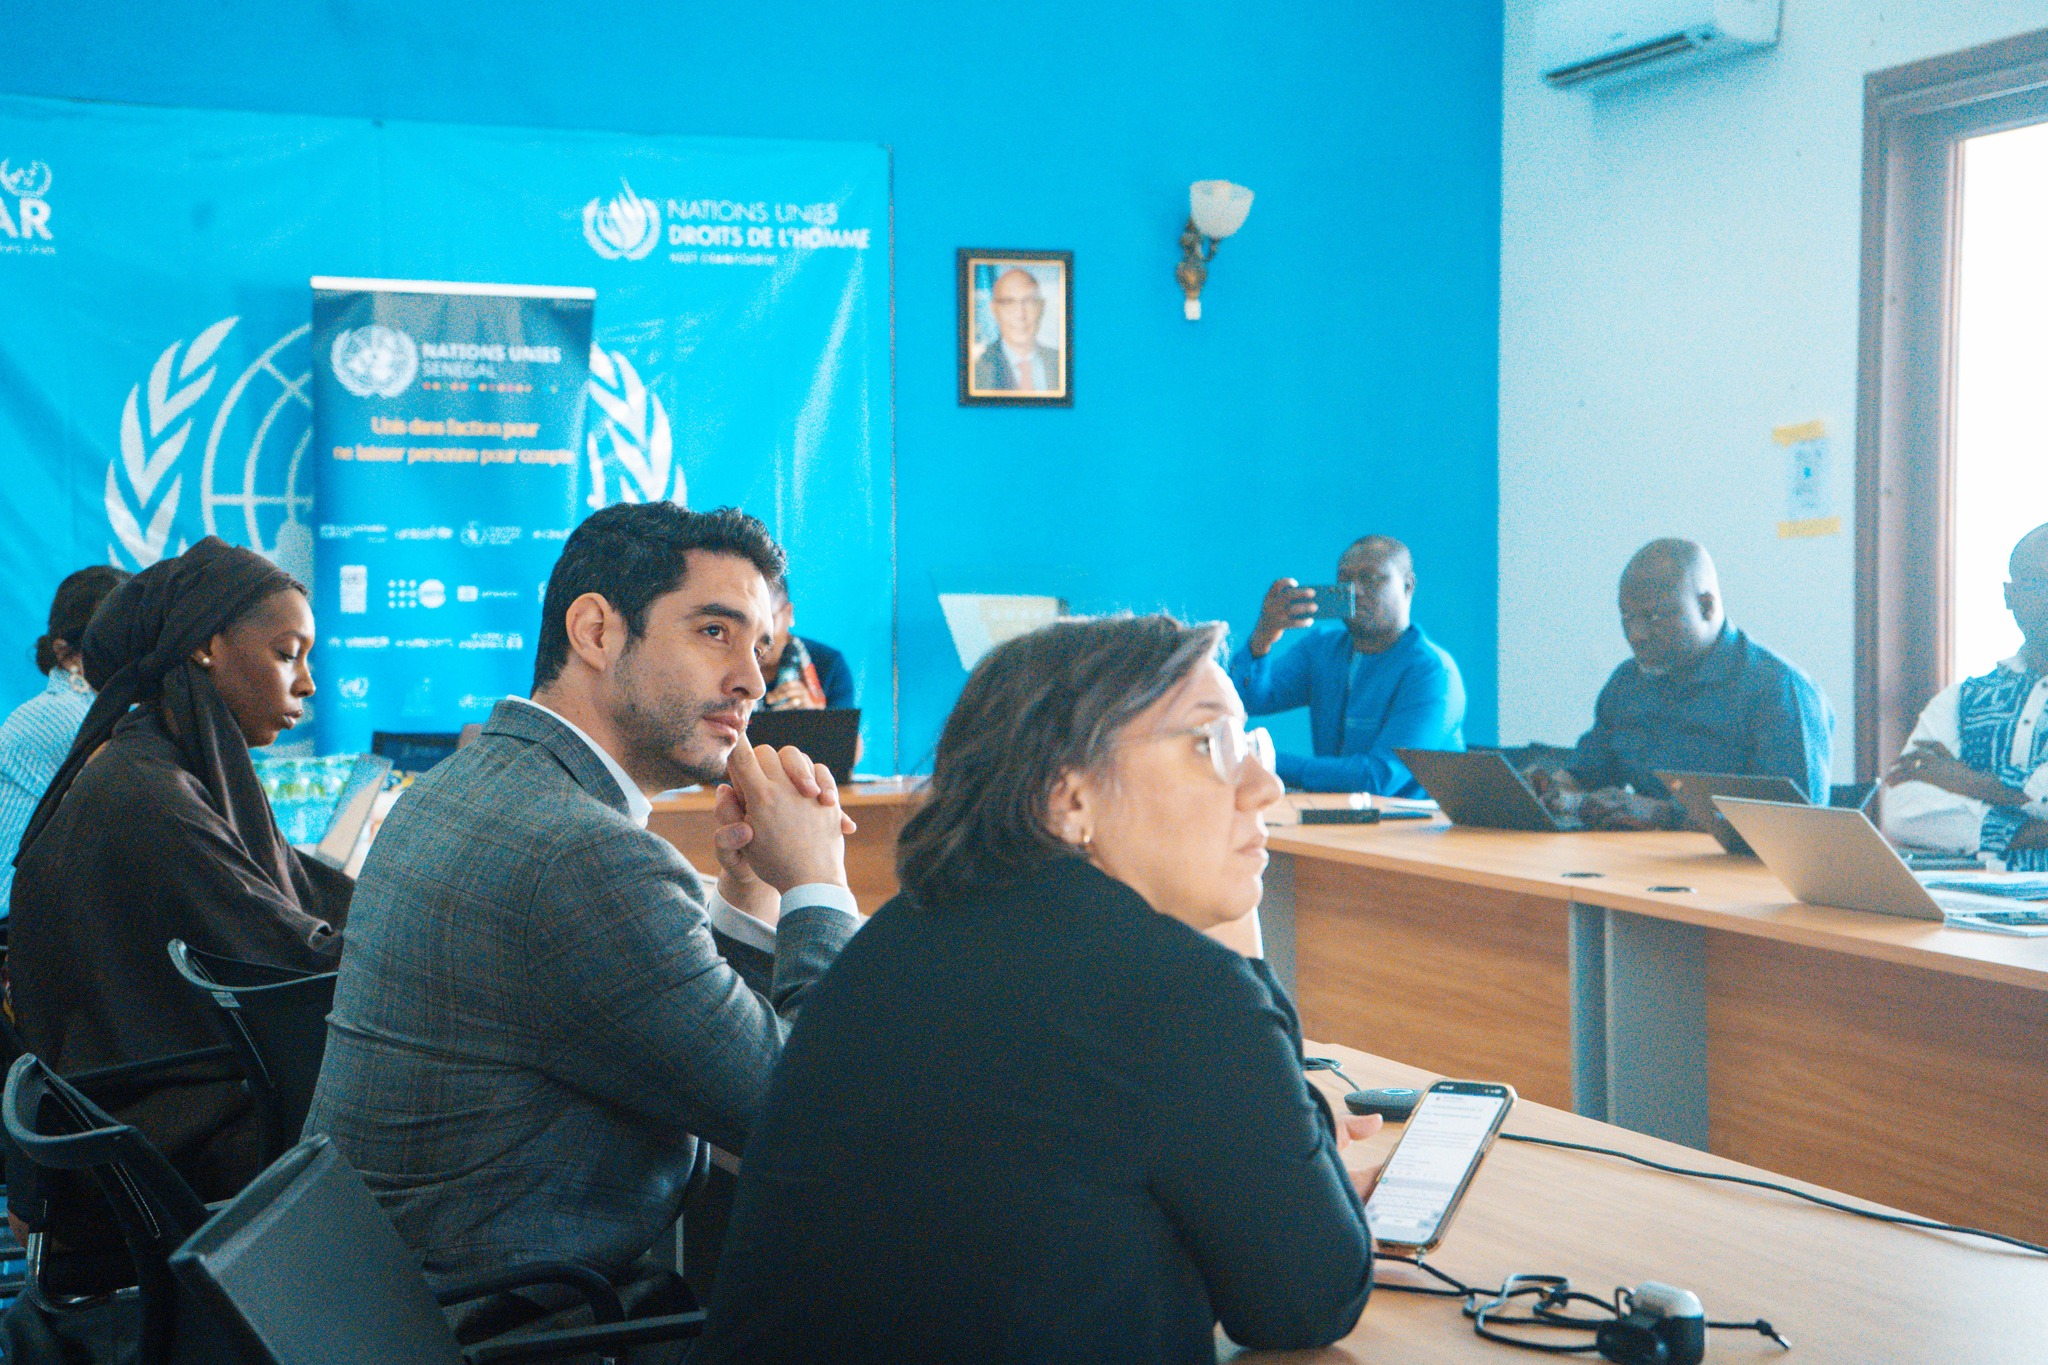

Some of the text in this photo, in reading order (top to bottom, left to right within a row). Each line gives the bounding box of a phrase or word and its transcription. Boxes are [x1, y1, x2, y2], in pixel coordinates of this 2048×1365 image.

[667, 199, 838, 225] NATIONS UNIES
[668, 224, 743, 247] DROITS
[746, 226, 773, 248] DE
[421, 343, 505, 361] NATIONS
[502, 423, 539, 441] pour
